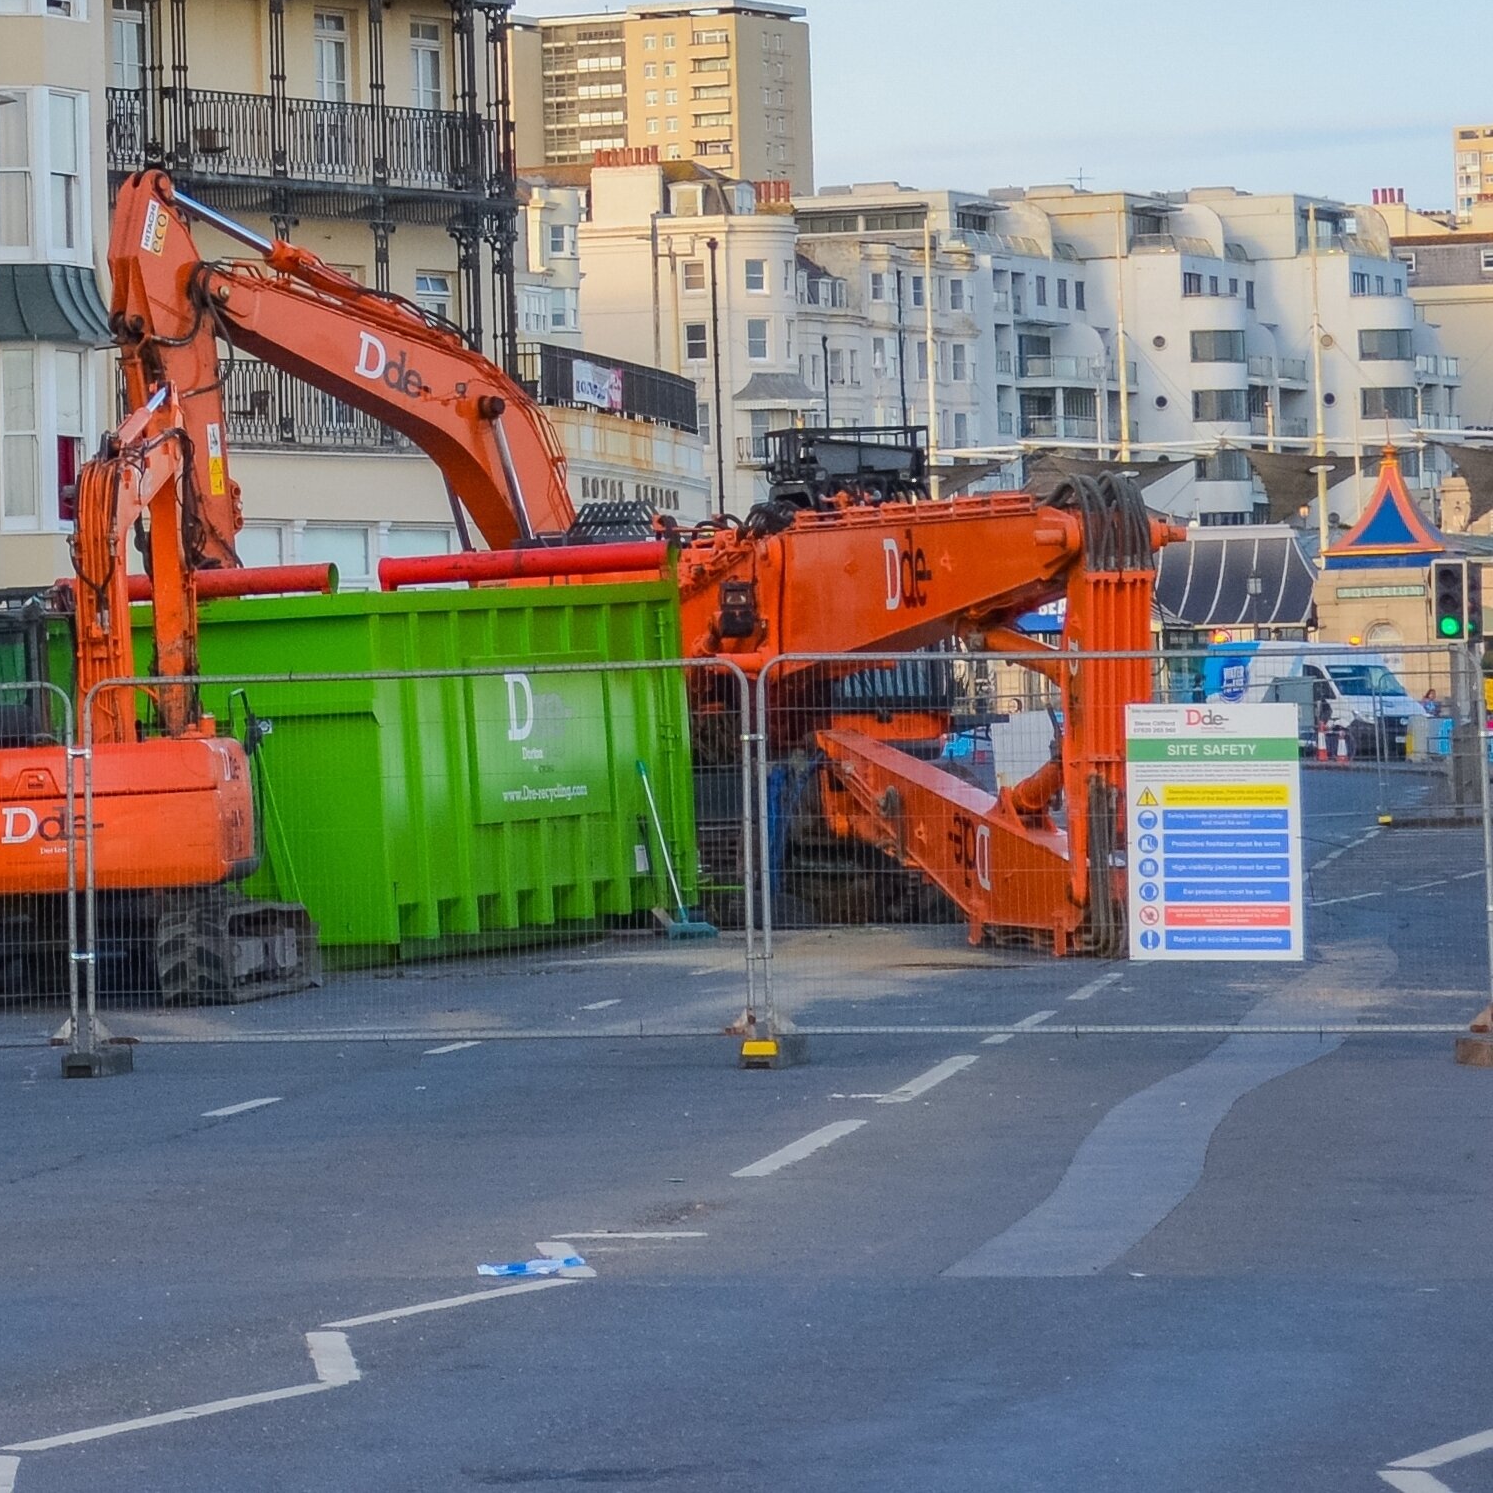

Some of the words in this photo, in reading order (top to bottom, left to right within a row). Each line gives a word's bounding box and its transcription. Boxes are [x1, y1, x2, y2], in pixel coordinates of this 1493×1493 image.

[143, 203, 157, 248] HITACHI
[1167, 744, 1198, 756] SITE
[1203, 744, 1257, 755] SAFETY
